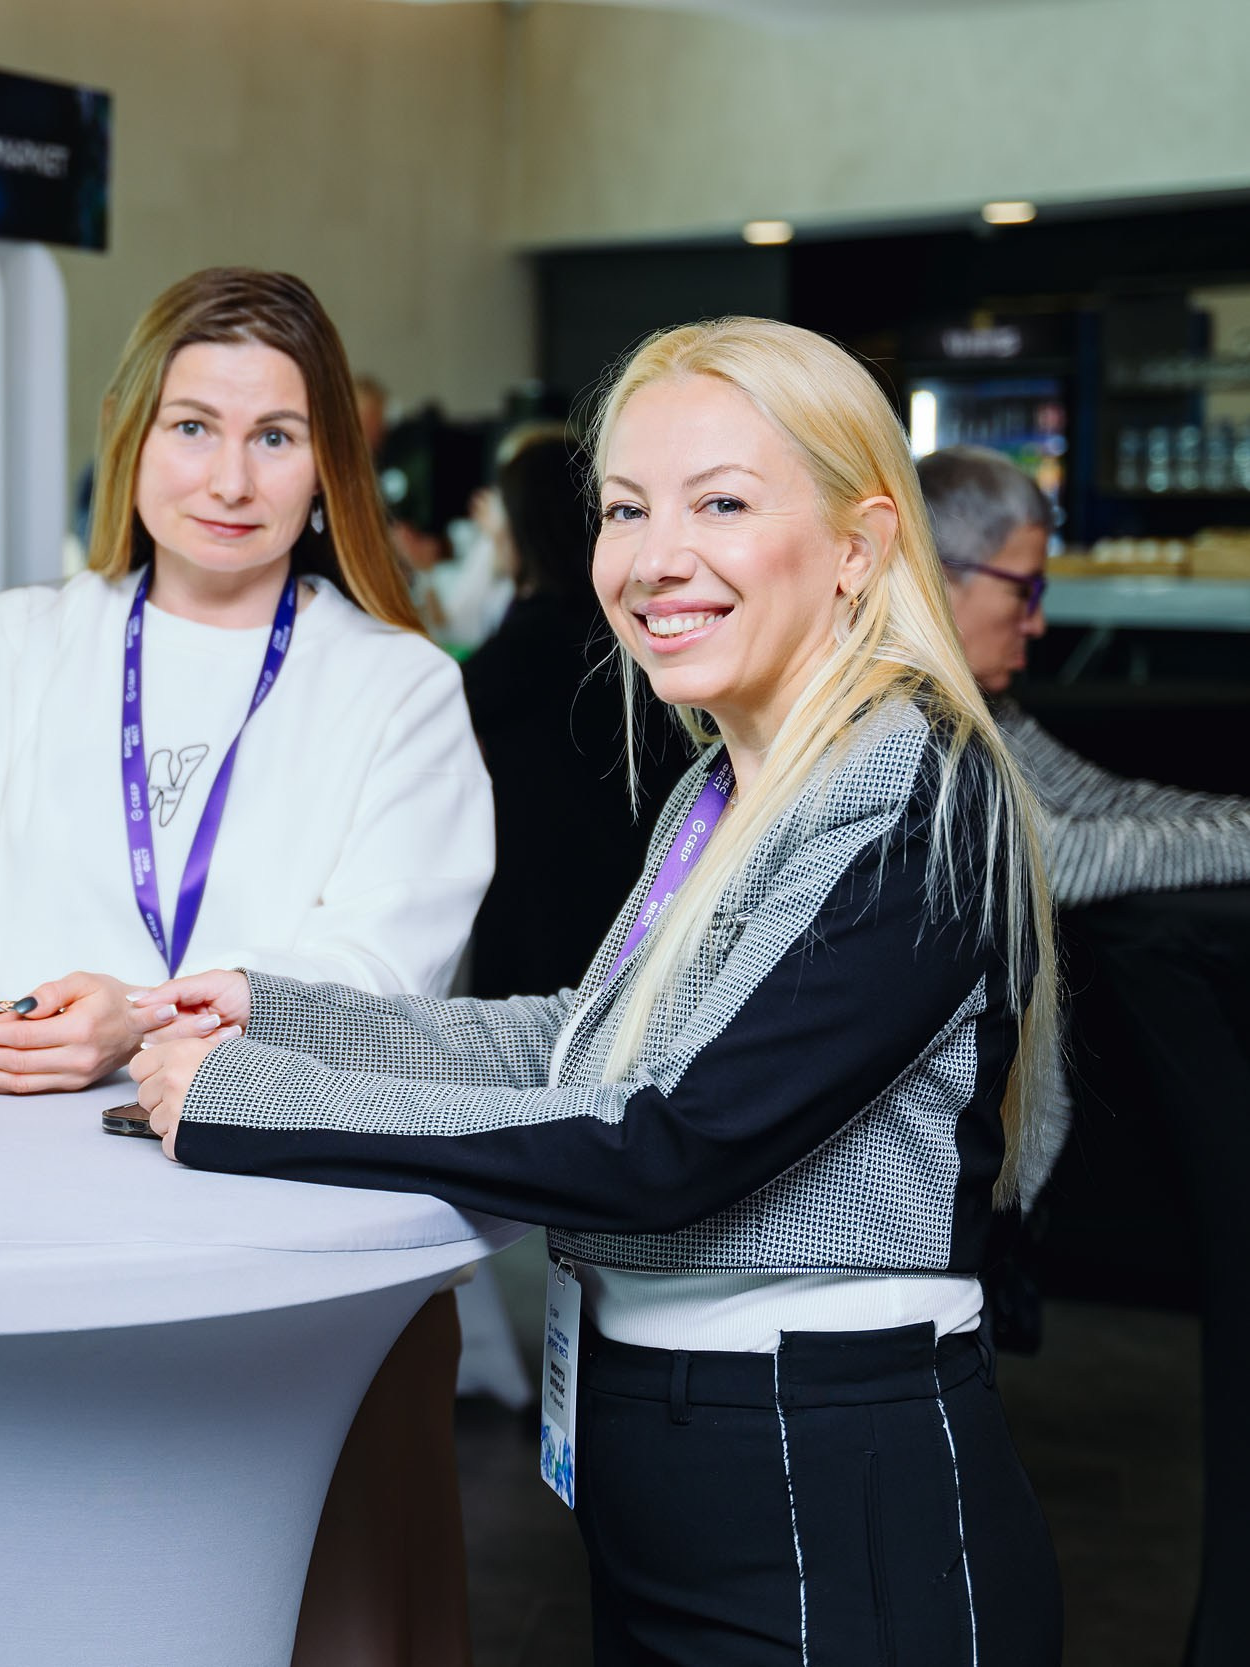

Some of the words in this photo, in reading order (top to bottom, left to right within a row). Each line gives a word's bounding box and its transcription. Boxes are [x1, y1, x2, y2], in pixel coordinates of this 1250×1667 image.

[712, 763, 730, 791] ФЕСТ
[719, 767, 736, 796] ЗНЕС
[130, 782, 141, 808] СБЕР
[679, 833, 698, 863] СБЕР
[641, 901, 659, 928] ФЕСТ
